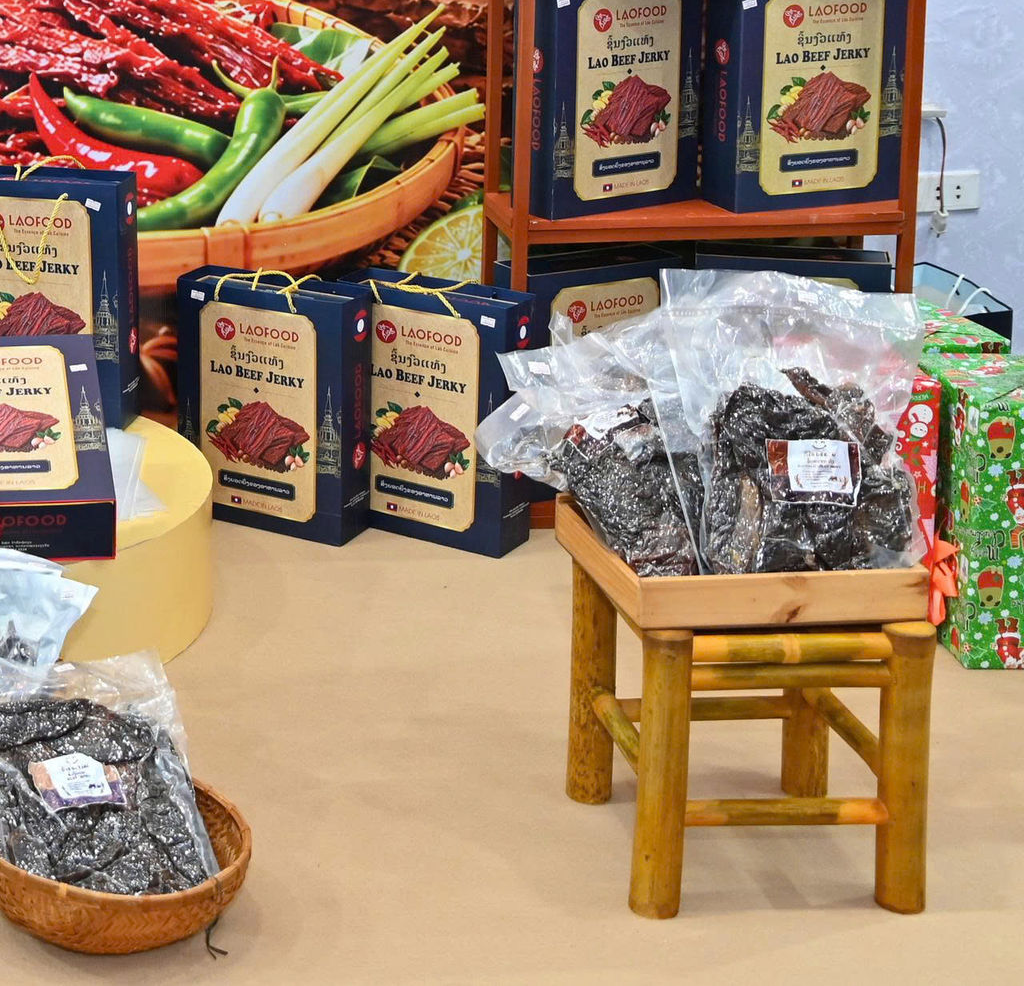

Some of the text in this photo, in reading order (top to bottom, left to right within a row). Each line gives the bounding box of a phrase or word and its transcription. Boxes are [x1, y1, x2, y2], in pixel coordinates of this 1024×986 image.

[616, 5, 667, 21] LAOFOOD
[808, 2, 868, 17] LAOFOOD
[588, 50, 671, 69] LAO BEEF JERKY
[776, 47, 871, 64] LAO BEEF JERKY
[531, 78, 543, 151] LAOFOOD
[718, 70, 728, 142] LAOFOOD
[40, 260, 80, 275] JERKY
[590, 294, 644, 312] LAOFOOD
[239, 323, 299, 343] LAOFOOD
[401, 326, 462, 347] LAOFOOD
[210, 360, 305, 389] LAO BEEF JERKY
[370, 363, 467, 394] LAO BEEF JERKY
[6, 387, 52, 396] JERKY
[1, 514, 67, 527] OFOOD
